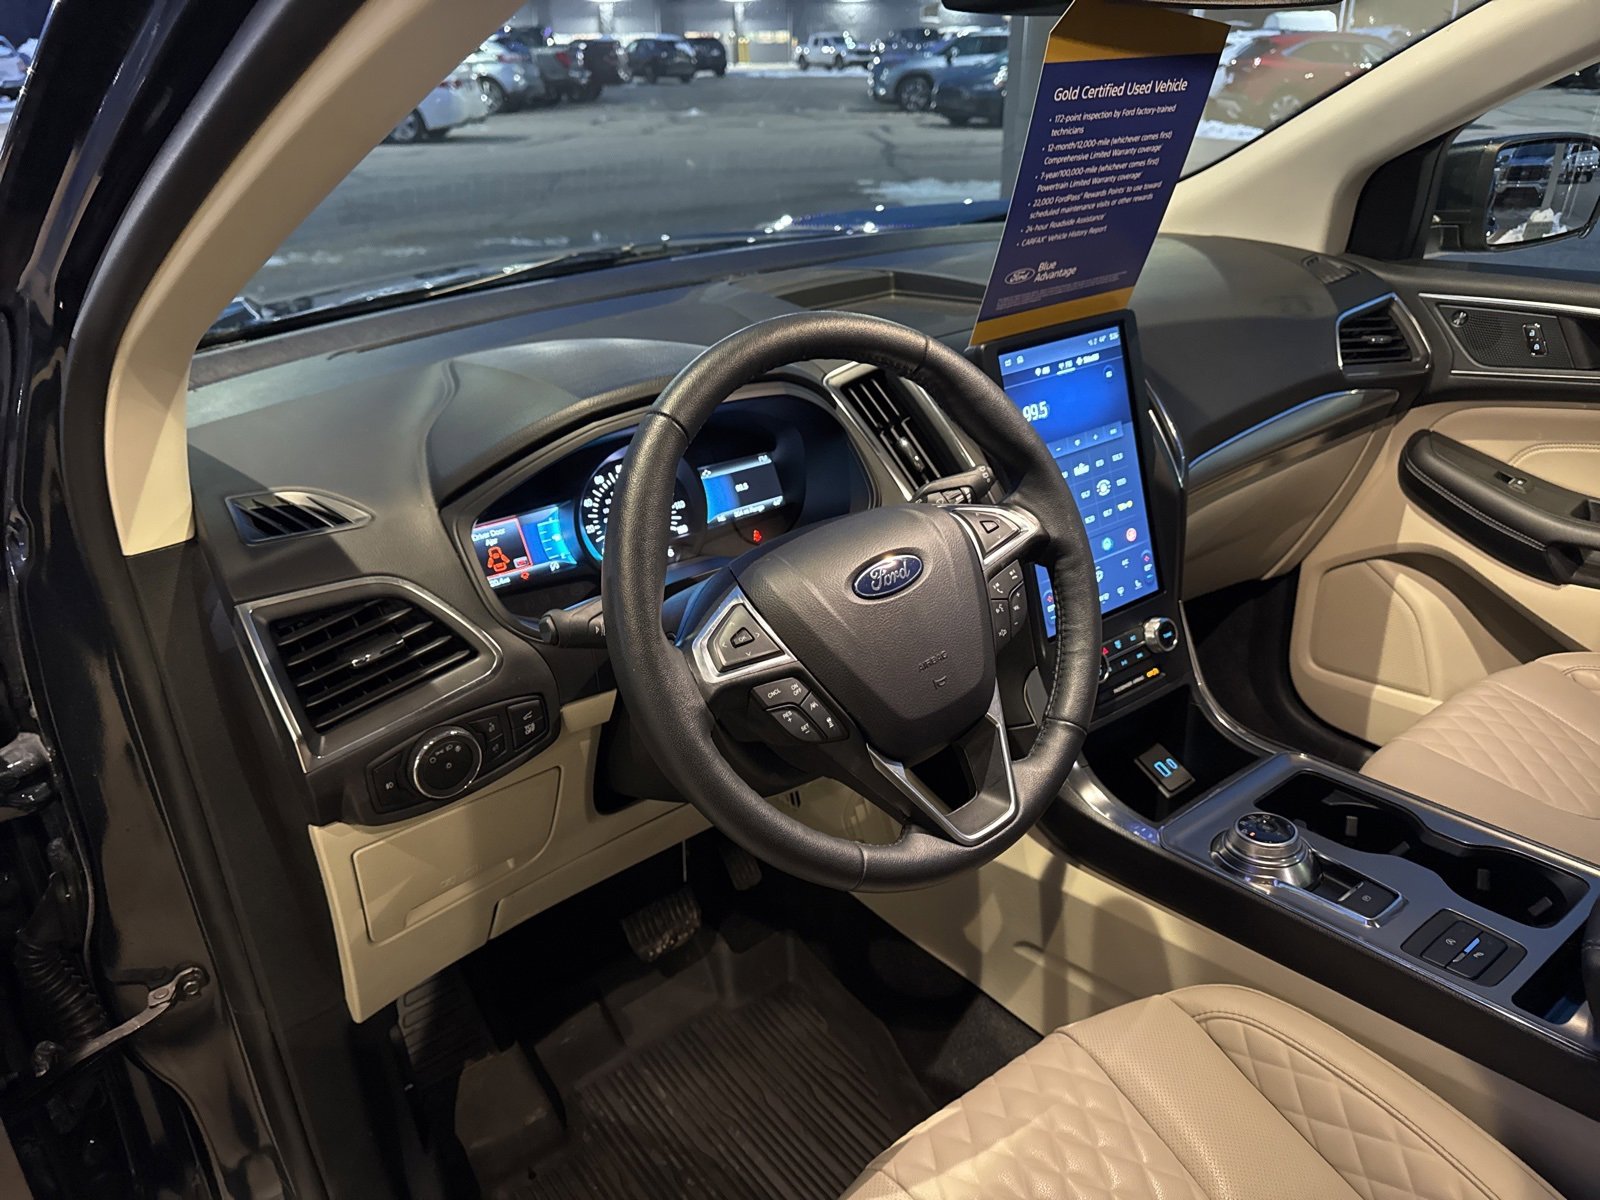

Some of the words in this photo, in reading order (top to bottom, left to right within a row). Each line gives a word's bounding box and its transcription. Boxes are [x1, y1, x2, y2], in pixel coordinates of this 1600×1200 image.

[1054, 86, 1080, 102] Gold
[1082, 81, 1124, 99] Certified
[1127, 80, 1153, 96] Used
[1155, 77, 1188, 93] Vehicle
[1055, 113, 1081, 123] 172-point
[1083, 110, 1113, 122] inspection
[1114, 109, 1121, 118] by
[1122, 107, 1135, 116] Ford
[1136, 104, 1176, 115] factory-trained
[1051, 126, 1084, 137] technicians
[1048, 136, 1110, 152] 12-month/12,000-mile
[1111, 134, 1141, 147] (whichever
[1141, 133, 1159, 141] comes
[1159, 130, 1173, 140] first)
[1044, 153, 1088, 165] Comprehensive
[1090, 149, 1111, 160] Limited
[1112, 146, 1136, 157] Warranty
[1040, 167, 1097, 180] 7-year/100,000-mile
[1098, 162, 1128, 174] (whichever
[1129, 160, 1146, 168] comes
[1146, 157, 1160, 167] first)
[1037, 181, 1068, 192] Powertrain
[1070, 177, 1090, 187] Limited
[1092, 175, 1116, 185] Warranty
[1033, 198, 1054, 208] 22,000
[1083, 190, 1107, 199] Rewards
[1144, 181, 1162, 190] toward
[1029, 207, 1059, 219] scheduled
[1061, 203, 1095, 214] maintenance
[1096, 200, 1110, 208] visits
[1118, 196, 1132, 205] other
[1025, 223, 1048, 234] 24-hour
[1050, 219, 1075, 229] Roadside
[1048, 232, 1067, 242] Vehicle
[1069, 229, 1088, 239] History
[1088, 225, 1107, 235] Report
[1033, 266, 1077, 283] Advantage
[1038, 261, 1057, 272] Blue
[1023, 401, 1048, 422] 99.5
[870, 559, 911, 591] Ford
[767, 688, 782, 699] CNCL
[793, 688, 802, 696] OFF
[782, 711, 792, 719] RES
[800, 723, 810, 732] SET
